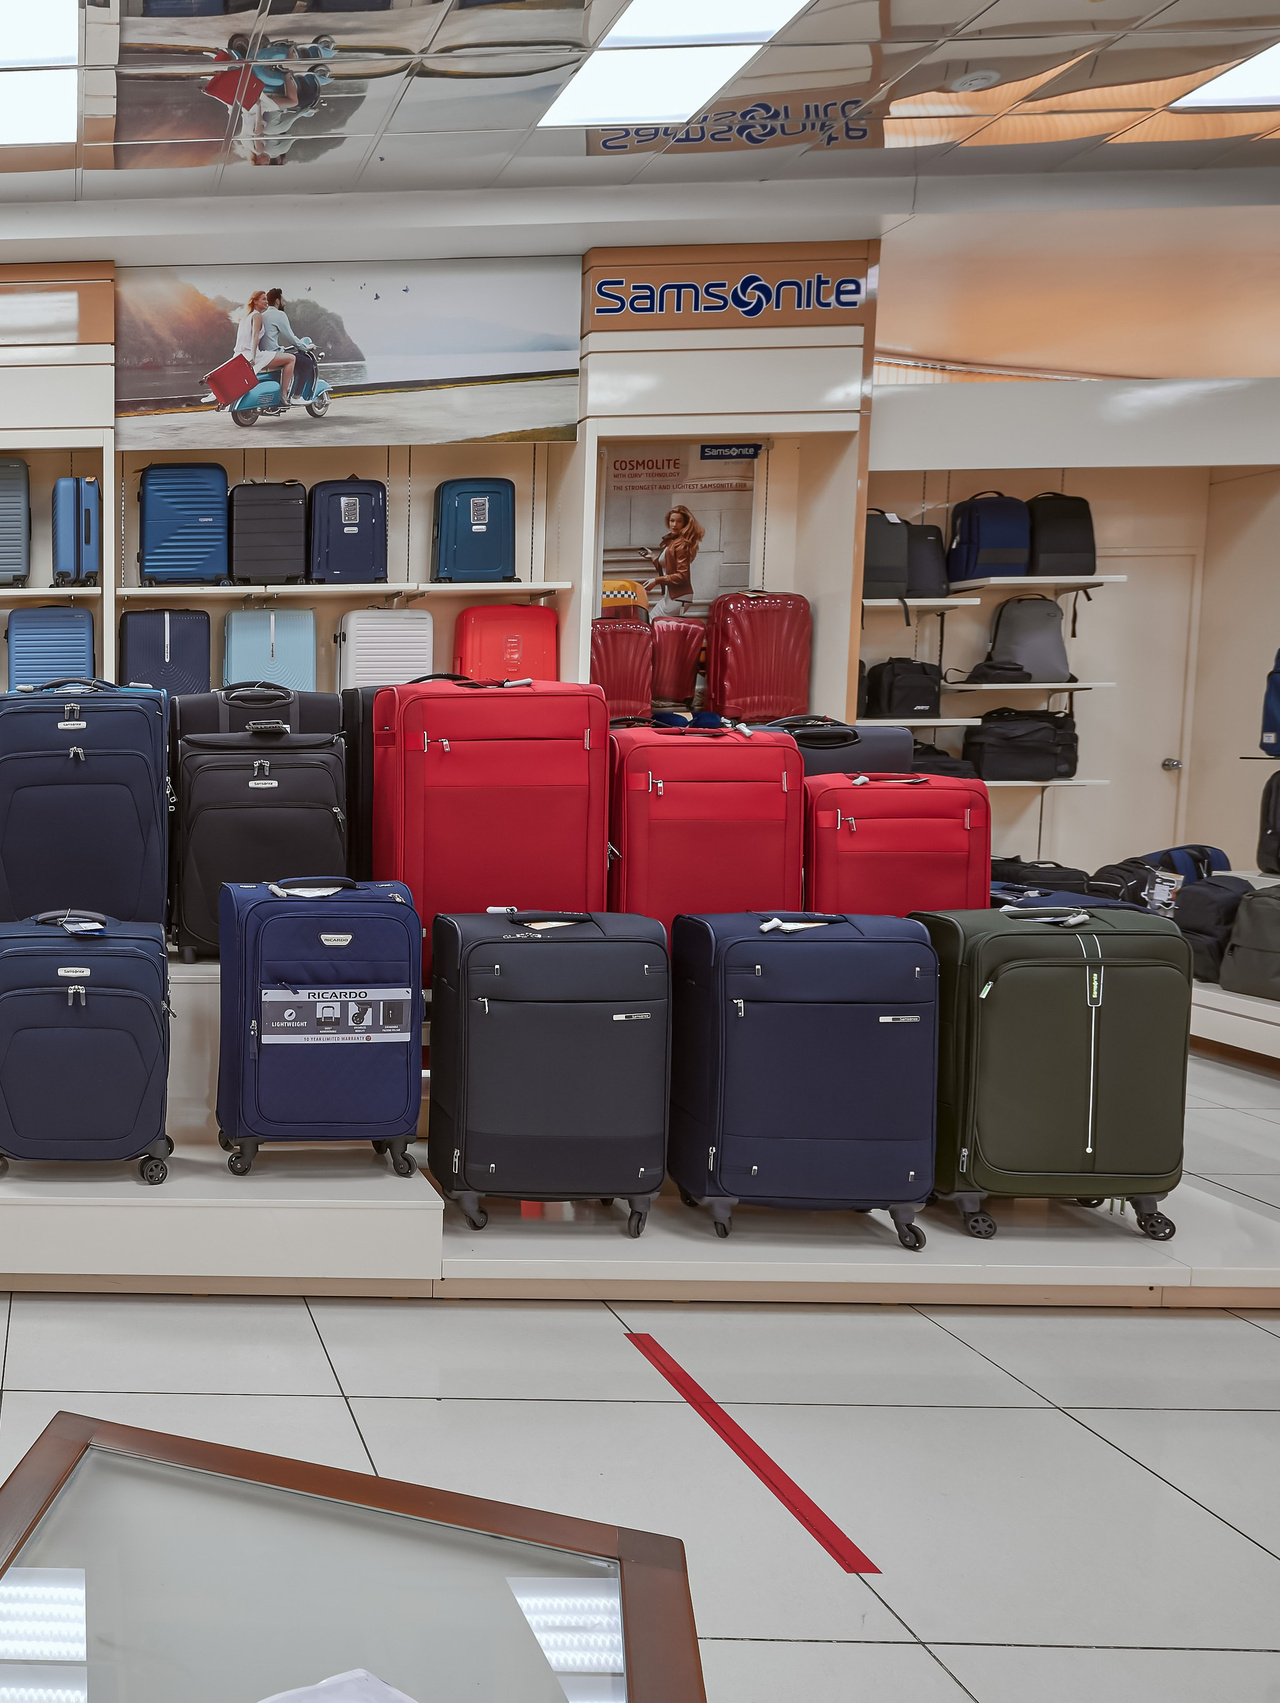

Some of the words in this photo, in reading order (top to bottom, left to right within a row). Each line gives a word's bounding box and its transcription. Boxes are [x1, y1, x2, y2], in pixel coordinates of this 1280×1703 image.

[595, 273, 862, 318] Samsonite
[704, 447, 755, 456] Samsonite
[613, 458, 681, 471] COSMOLITE
[700, 482, 734, 490] SAMSONITE
[308, 991, 368, 1000] RICARDO
